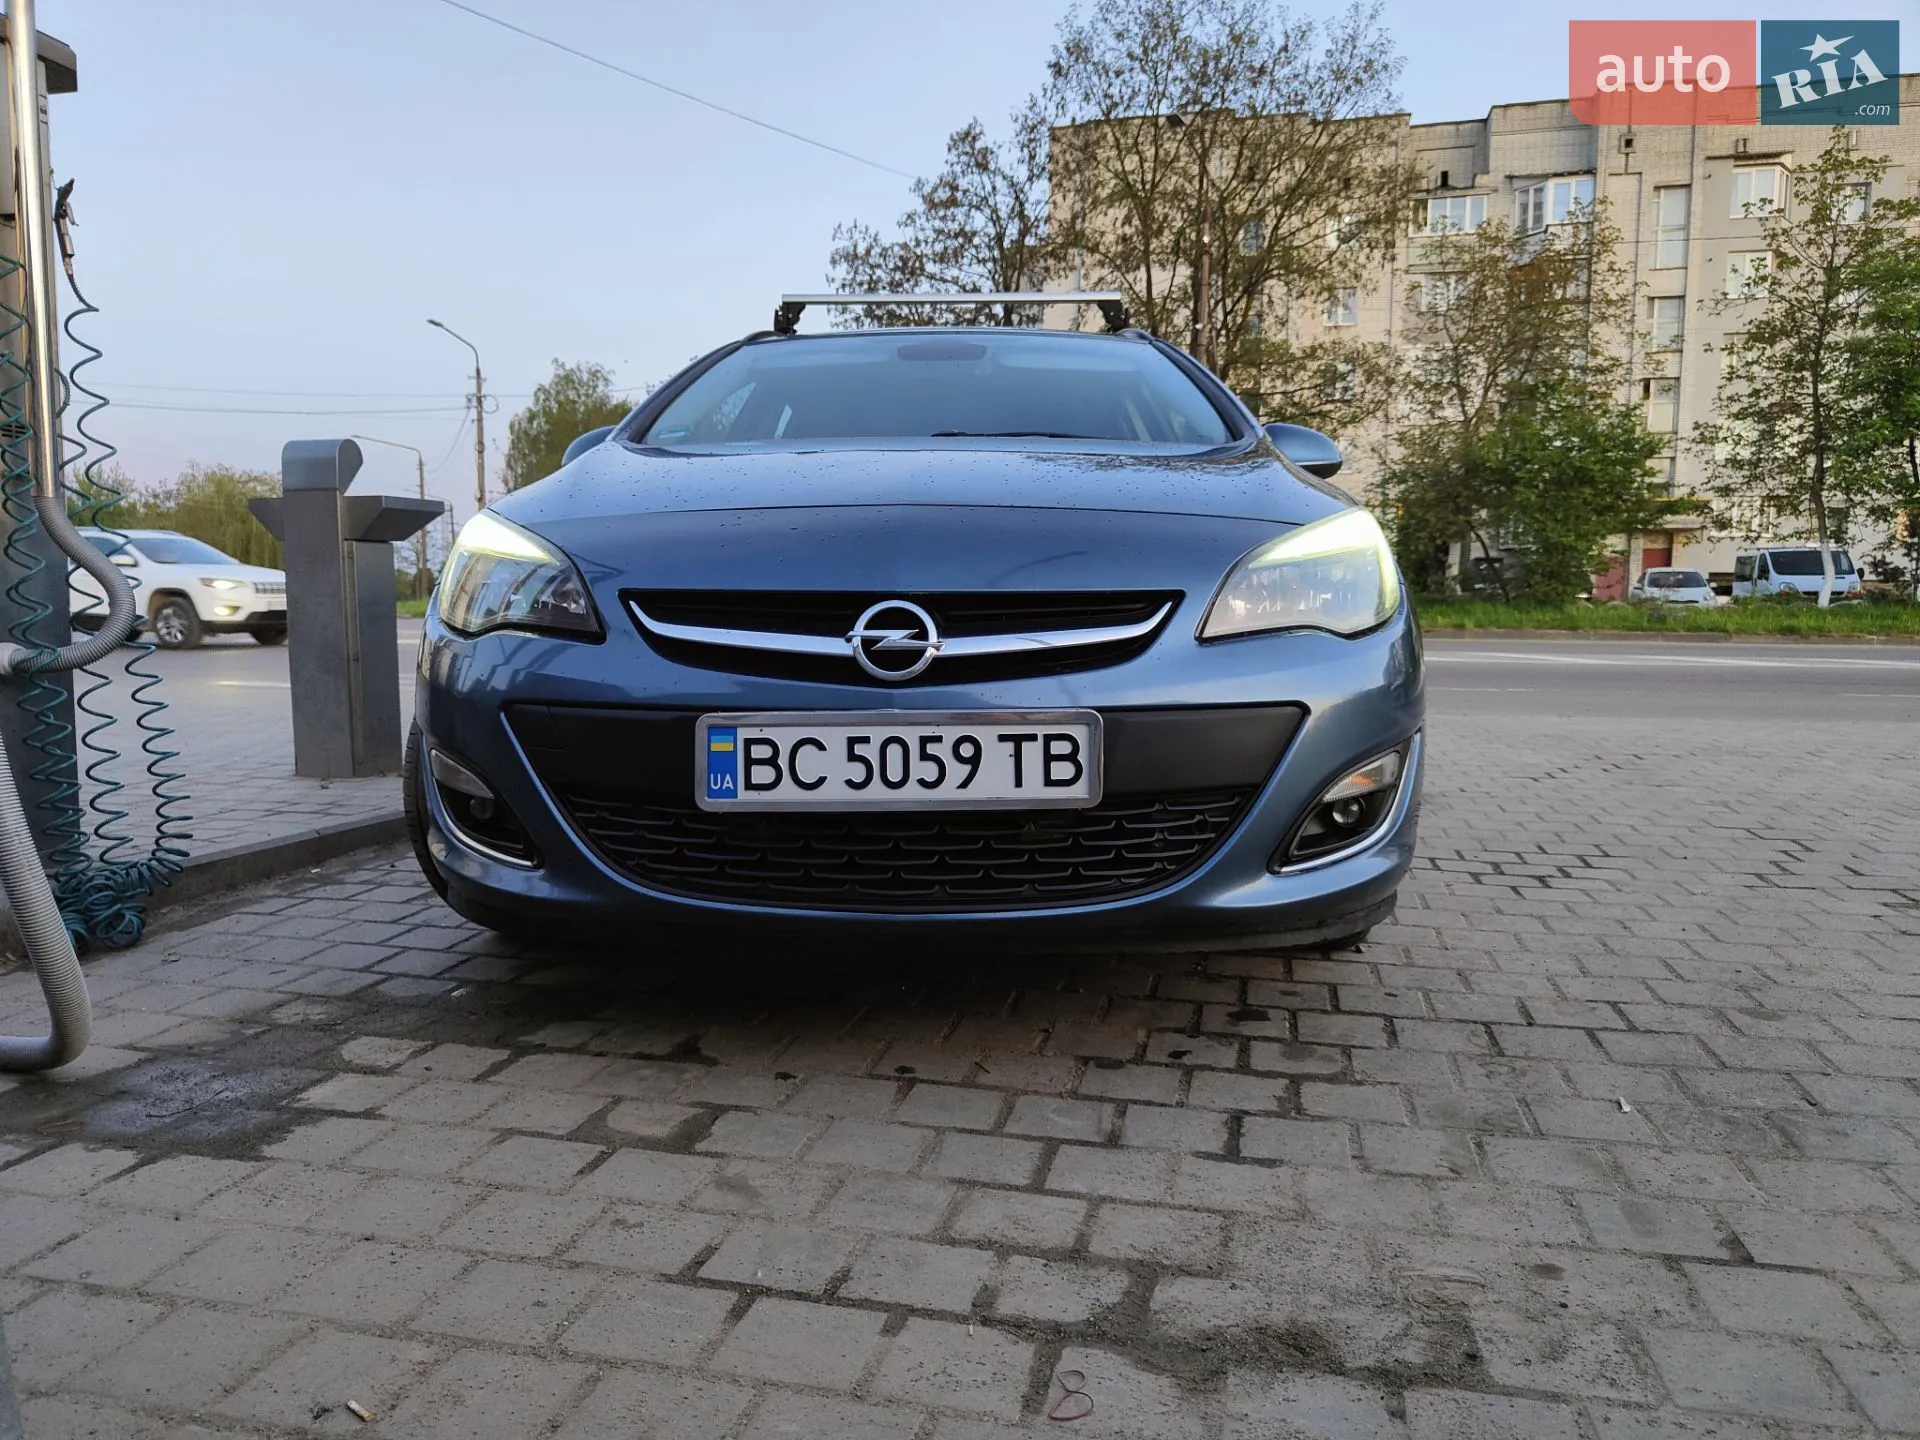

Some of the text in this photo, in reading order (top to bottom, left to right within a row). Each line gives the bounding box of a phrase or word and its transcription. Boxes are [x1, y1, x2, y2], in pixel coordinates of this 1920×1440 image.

[743, 732, 1084, 791] BC 5059 TB
[710, 773, 734, 790] UA
